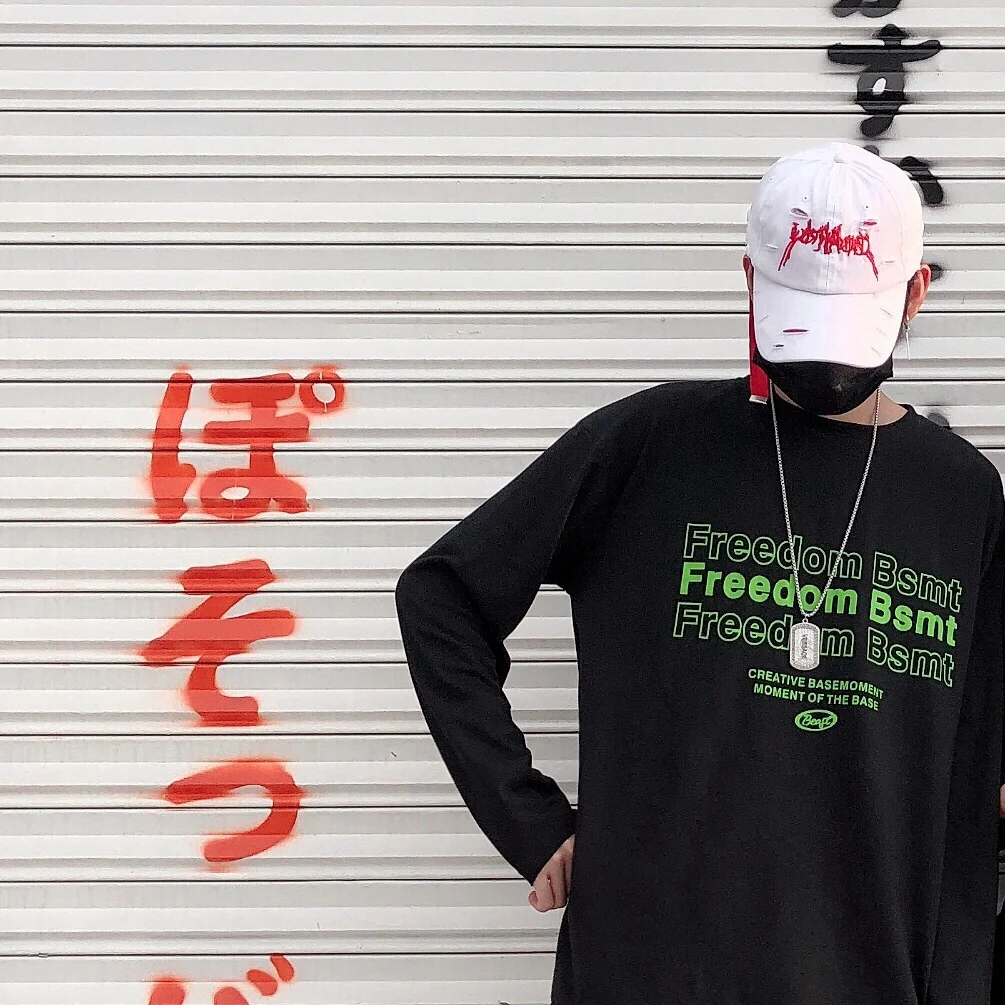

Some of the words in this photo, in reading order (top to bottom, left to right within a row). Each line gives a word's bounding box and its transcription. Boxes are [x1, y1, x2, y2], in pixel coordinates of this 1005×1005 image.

[679, 561, 859, 615] Freedom
[869, 588, 958, 647] Bsmt
[683, 522, 863, 580] Freedom
[872, 551, 962, 613] Bsmt
[673, 601, 855, 658] Freedm
[866, 626, 954, 688] Bsmt
[747, 668, 806, 688] CREATIVE
[808, 678, 884, 700] BASEMOMENT
[753, 683, 806, 702] MOMENT
[807, 692, 825, 704] OF
[827, 694, 850, 705] THE
[851, 695, 880, 711] BASE
